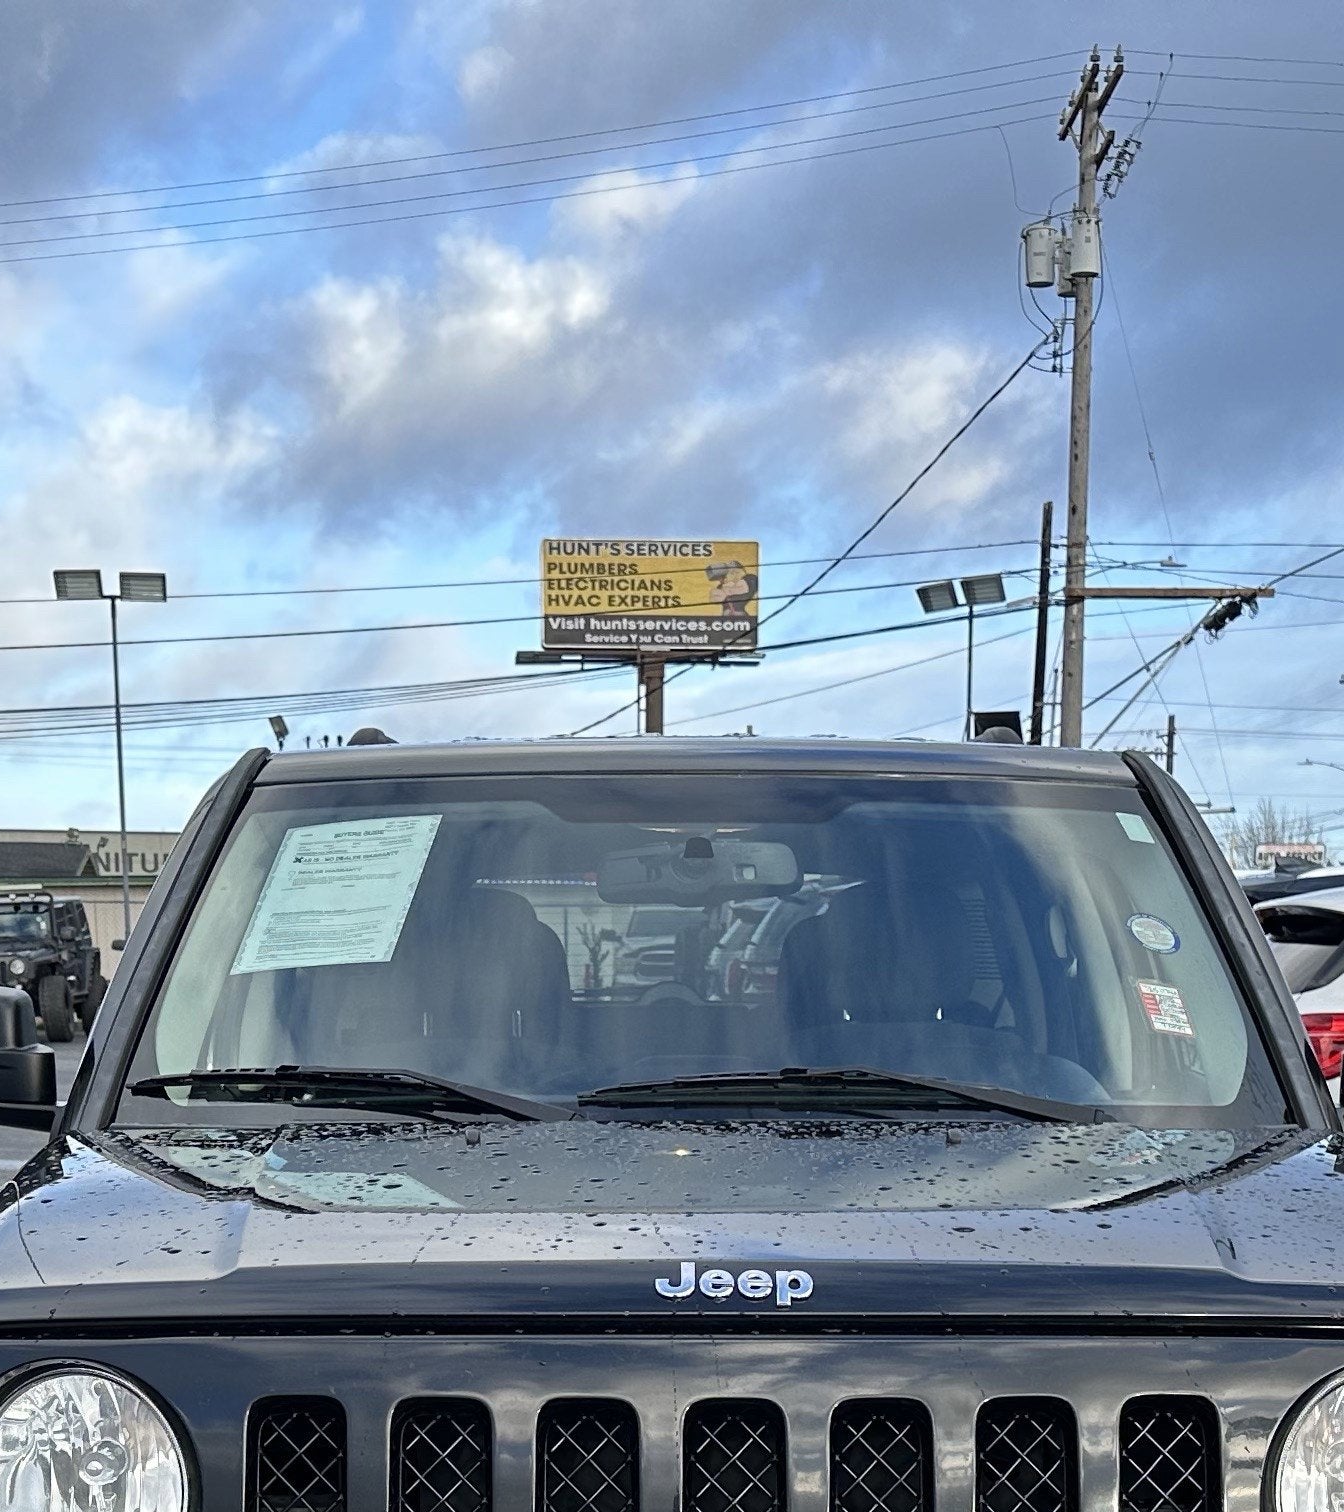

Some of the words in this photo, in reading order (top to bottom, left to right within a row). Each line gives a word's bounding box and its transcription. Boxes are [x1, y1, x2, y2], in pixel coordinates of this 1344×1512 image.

[548, 542, 621, 556] HUNT'S
[625, 543, 713, 557] SERVICES
[547, 562, 639, 576] PLUMBERS
[547, 578, 673, 592] ELECTRICIANS
[547, 594, 601, 607] HVAC
[607, 595, 682, 608] EXPERTS
[549, 617, 586, 630] Visit
[590, 617, 750, 632] huntsservices.com
[584, 633, 629, 643] Service
[654, 633, 680, 644] Can
[680, 634, 709, 644] Trust
[655, 1261, 814, 1307] Jeep
